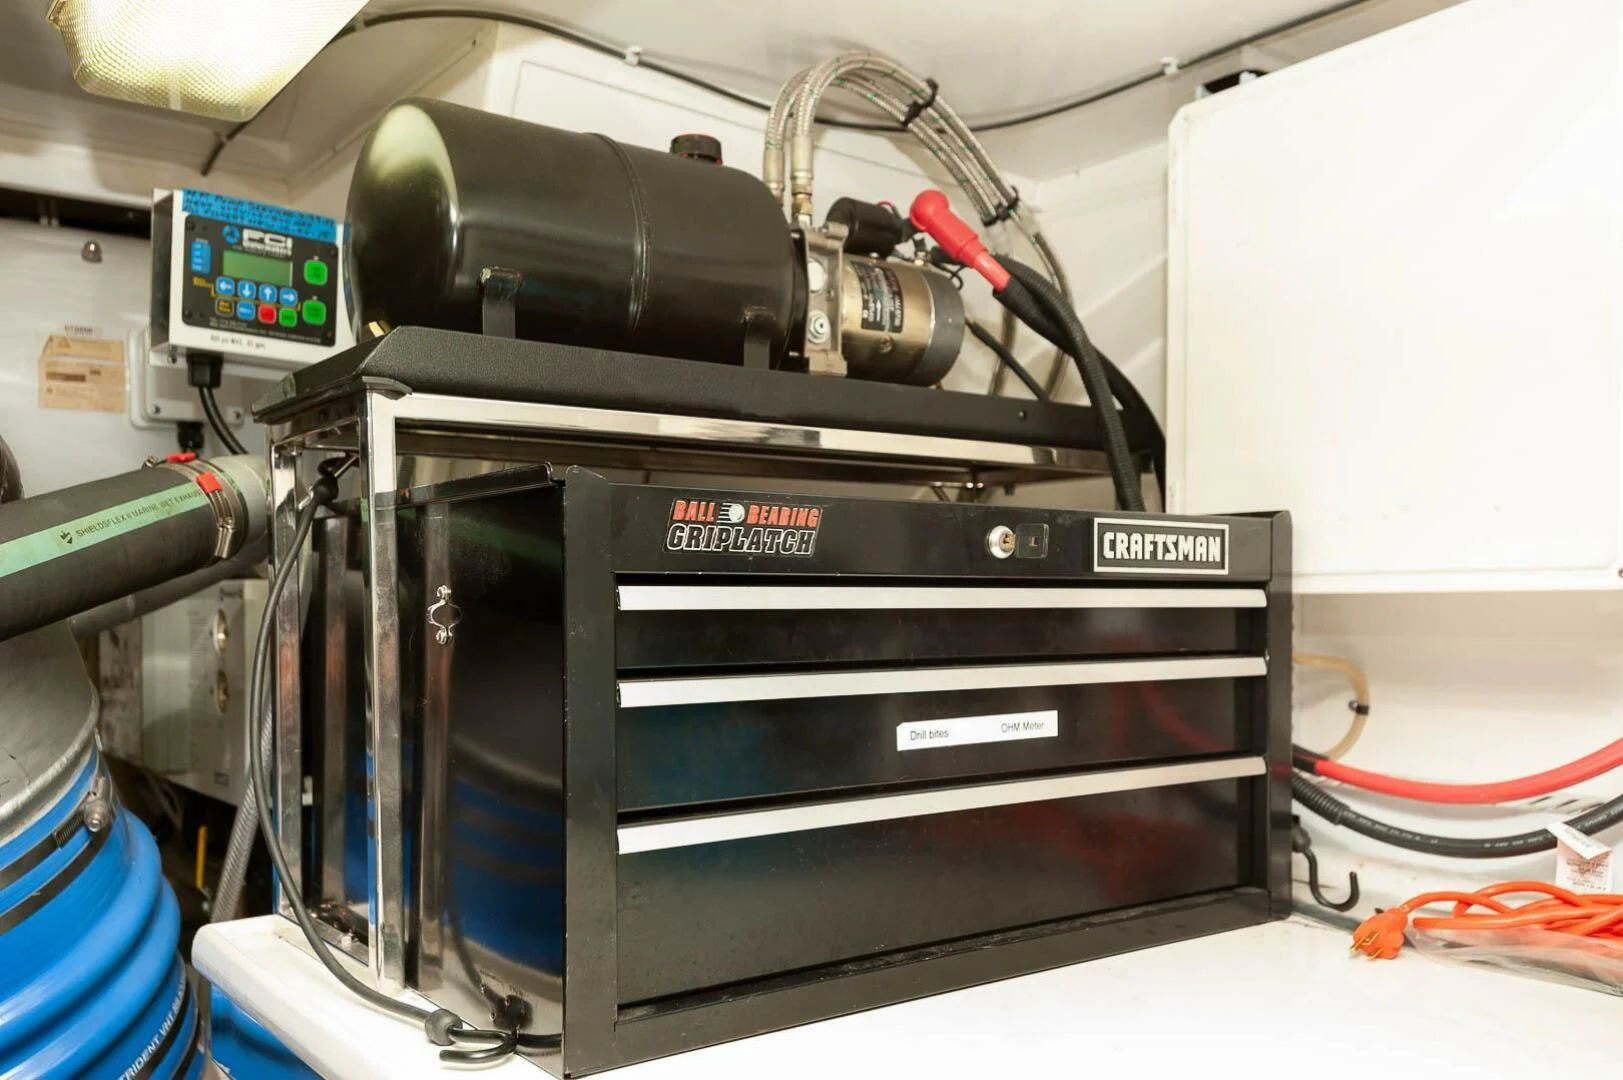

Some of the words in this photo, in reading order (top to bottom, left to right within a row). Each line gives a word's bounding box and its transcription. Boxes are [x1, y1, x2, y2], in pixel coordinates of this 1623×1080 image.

[672, 499, 716, 522] BALL
[746, 504, 821, 528] BEARING
[666, 523, 816, 555] GRIPLATCH
[1103, 531, 1221, 562] CRAFTSMAN
[910, 730, 927, 741] Drill
[929, 729, 949, 739] bites
[1001, 723, 1020, 733] OHM
[1023, 721, 1045, 731] Meter
